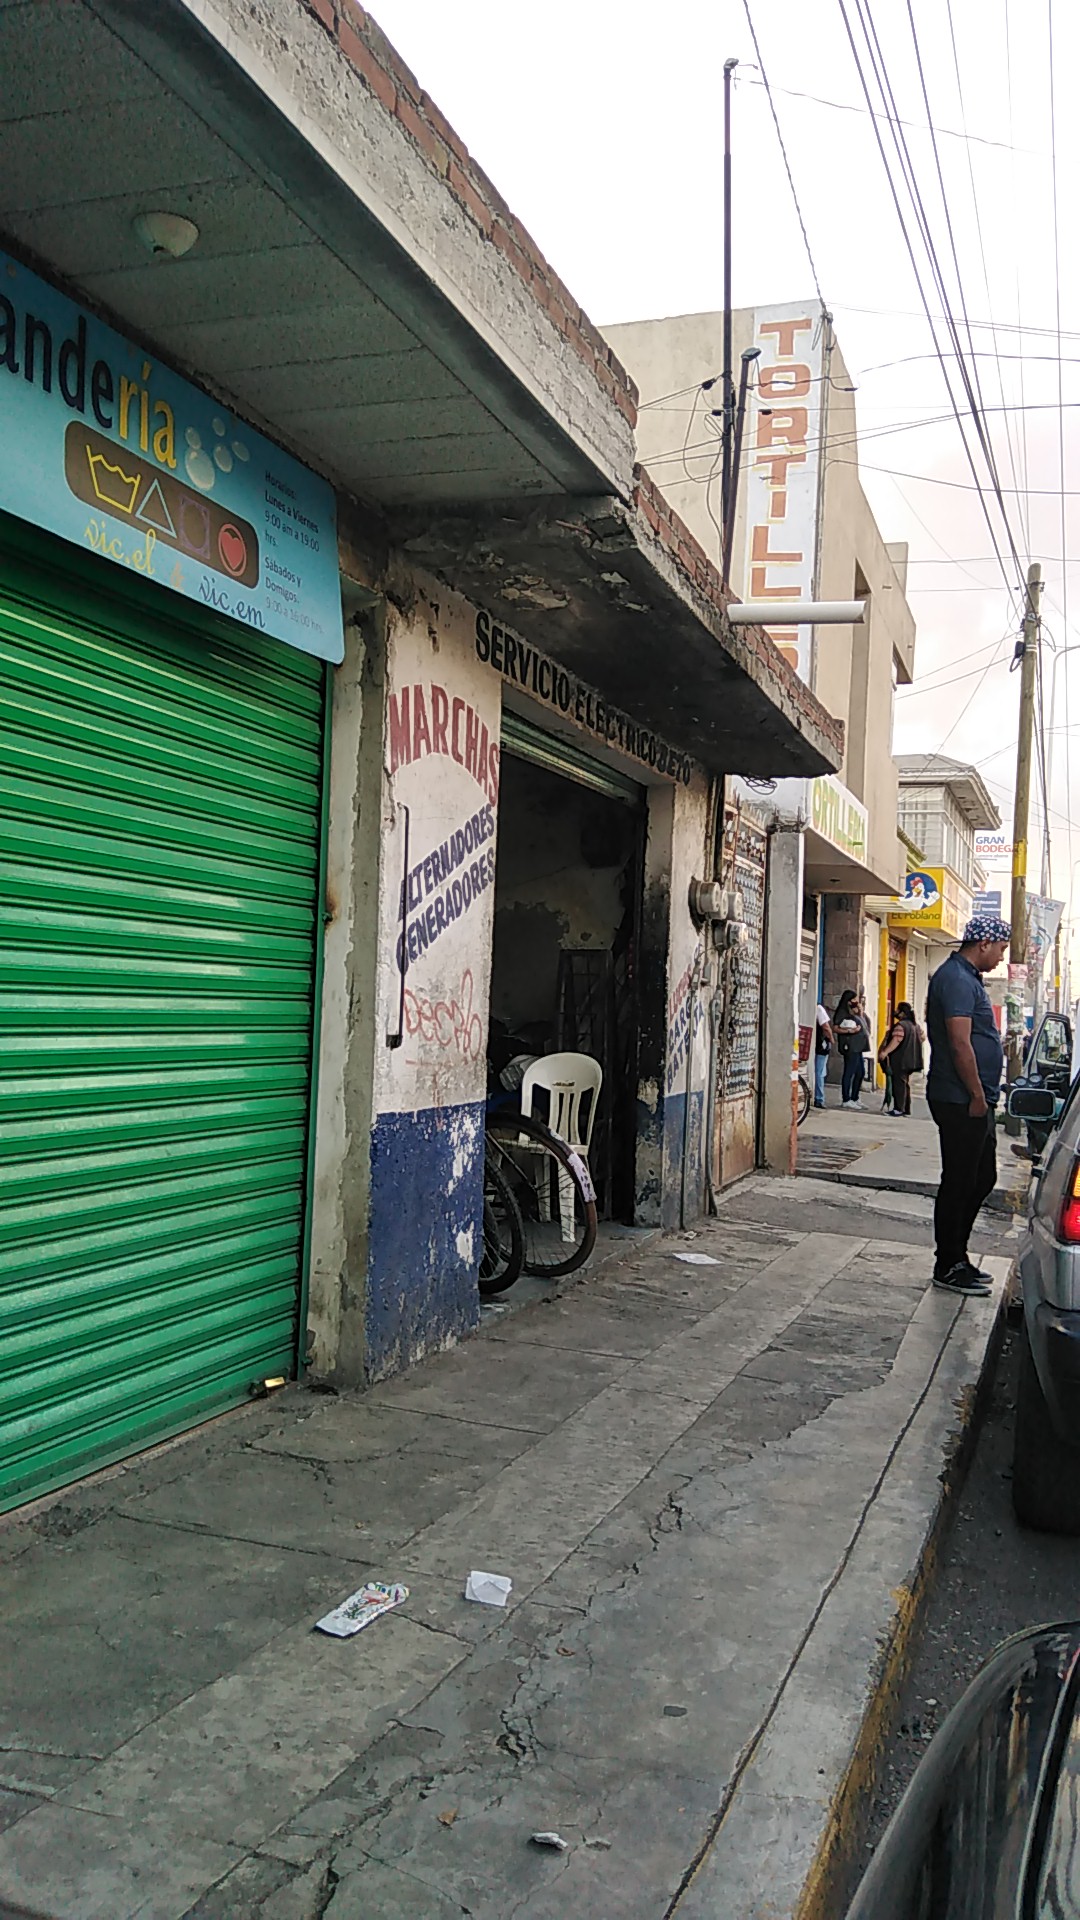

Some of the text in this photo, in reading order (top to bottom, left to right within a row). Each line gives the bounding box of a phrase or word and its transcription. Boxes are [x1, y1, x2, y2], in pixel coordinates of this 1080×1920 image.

[265, 489, 319, 534] Lunes a Viernes
[751, 319, 812, 671] TORTILL
[282, 522, 294, 537] am
[295, 530, 299, 540] a
[475, 610, 570, 712] SERVICIO
[388, 683, 500, 807] MARCHAS
[975, 836, 1005, 845] GRAN
[975, 845, 1014, 853] BODEG
